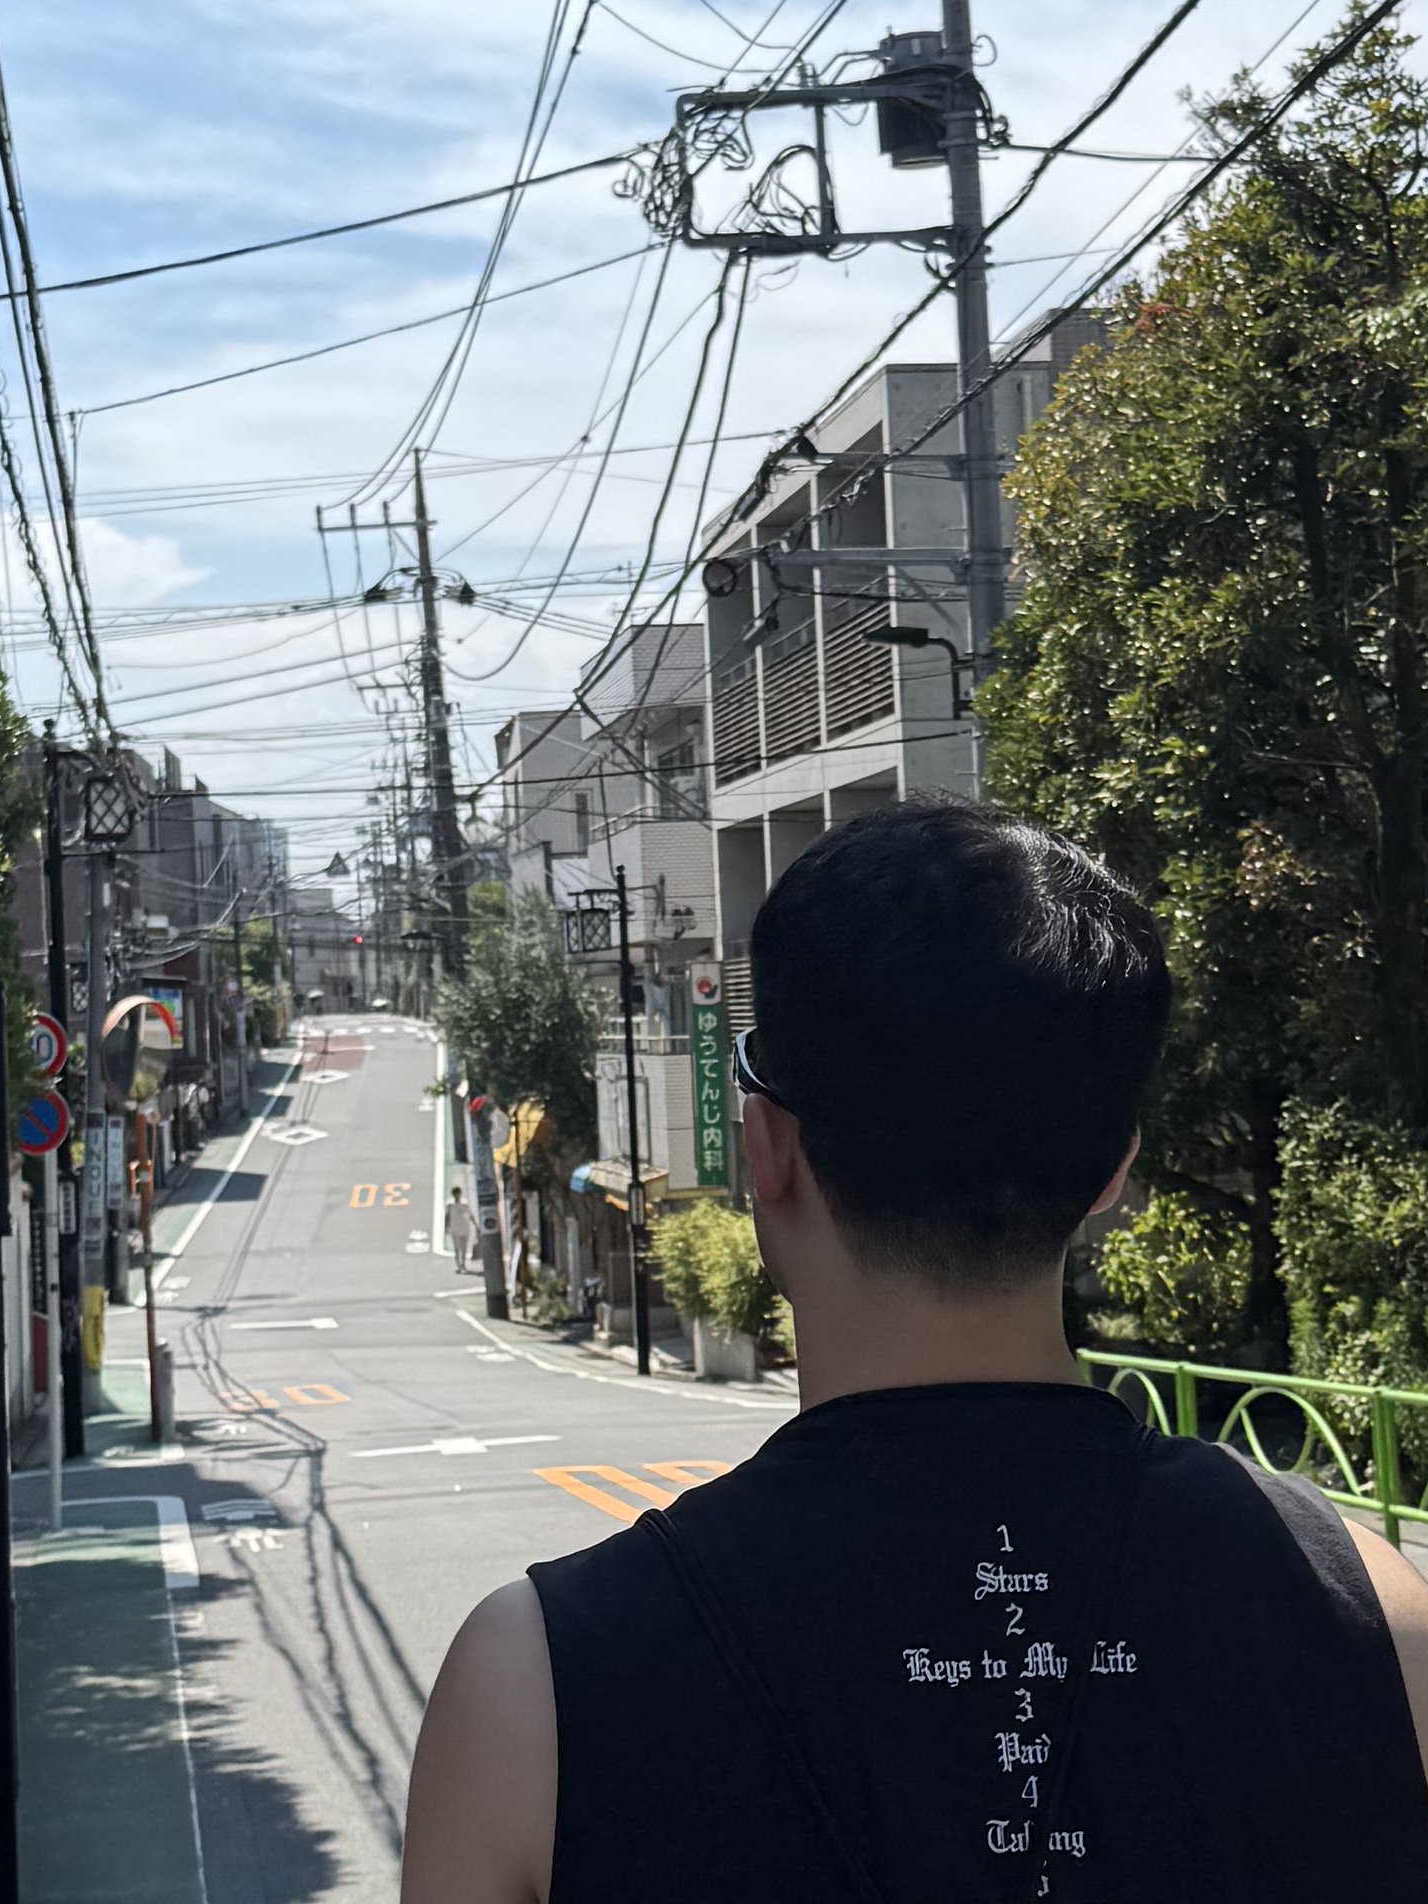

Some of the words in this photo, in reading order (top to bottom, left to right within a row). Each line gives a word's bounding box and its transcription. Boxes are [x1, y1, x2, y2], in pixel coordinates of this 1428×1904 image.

[698, 1011, 723, 1172] ゆうてんじ内科
[997, 1524, 1014, 1553] 1
[974, 1562, 1049, 1600] Stars
[1005, 1602, 1026, 1637] 2
[902, 1648, 972, 1687] Keys
[981, 1650, 1008, 1679] to
[1019, 1641, 1069, 1683] My
[1089, 1641, 1138, 1675] Life
[1014, 1688, 1035, 1722] 3
[1021, 1775, 1040, 1809] 4
